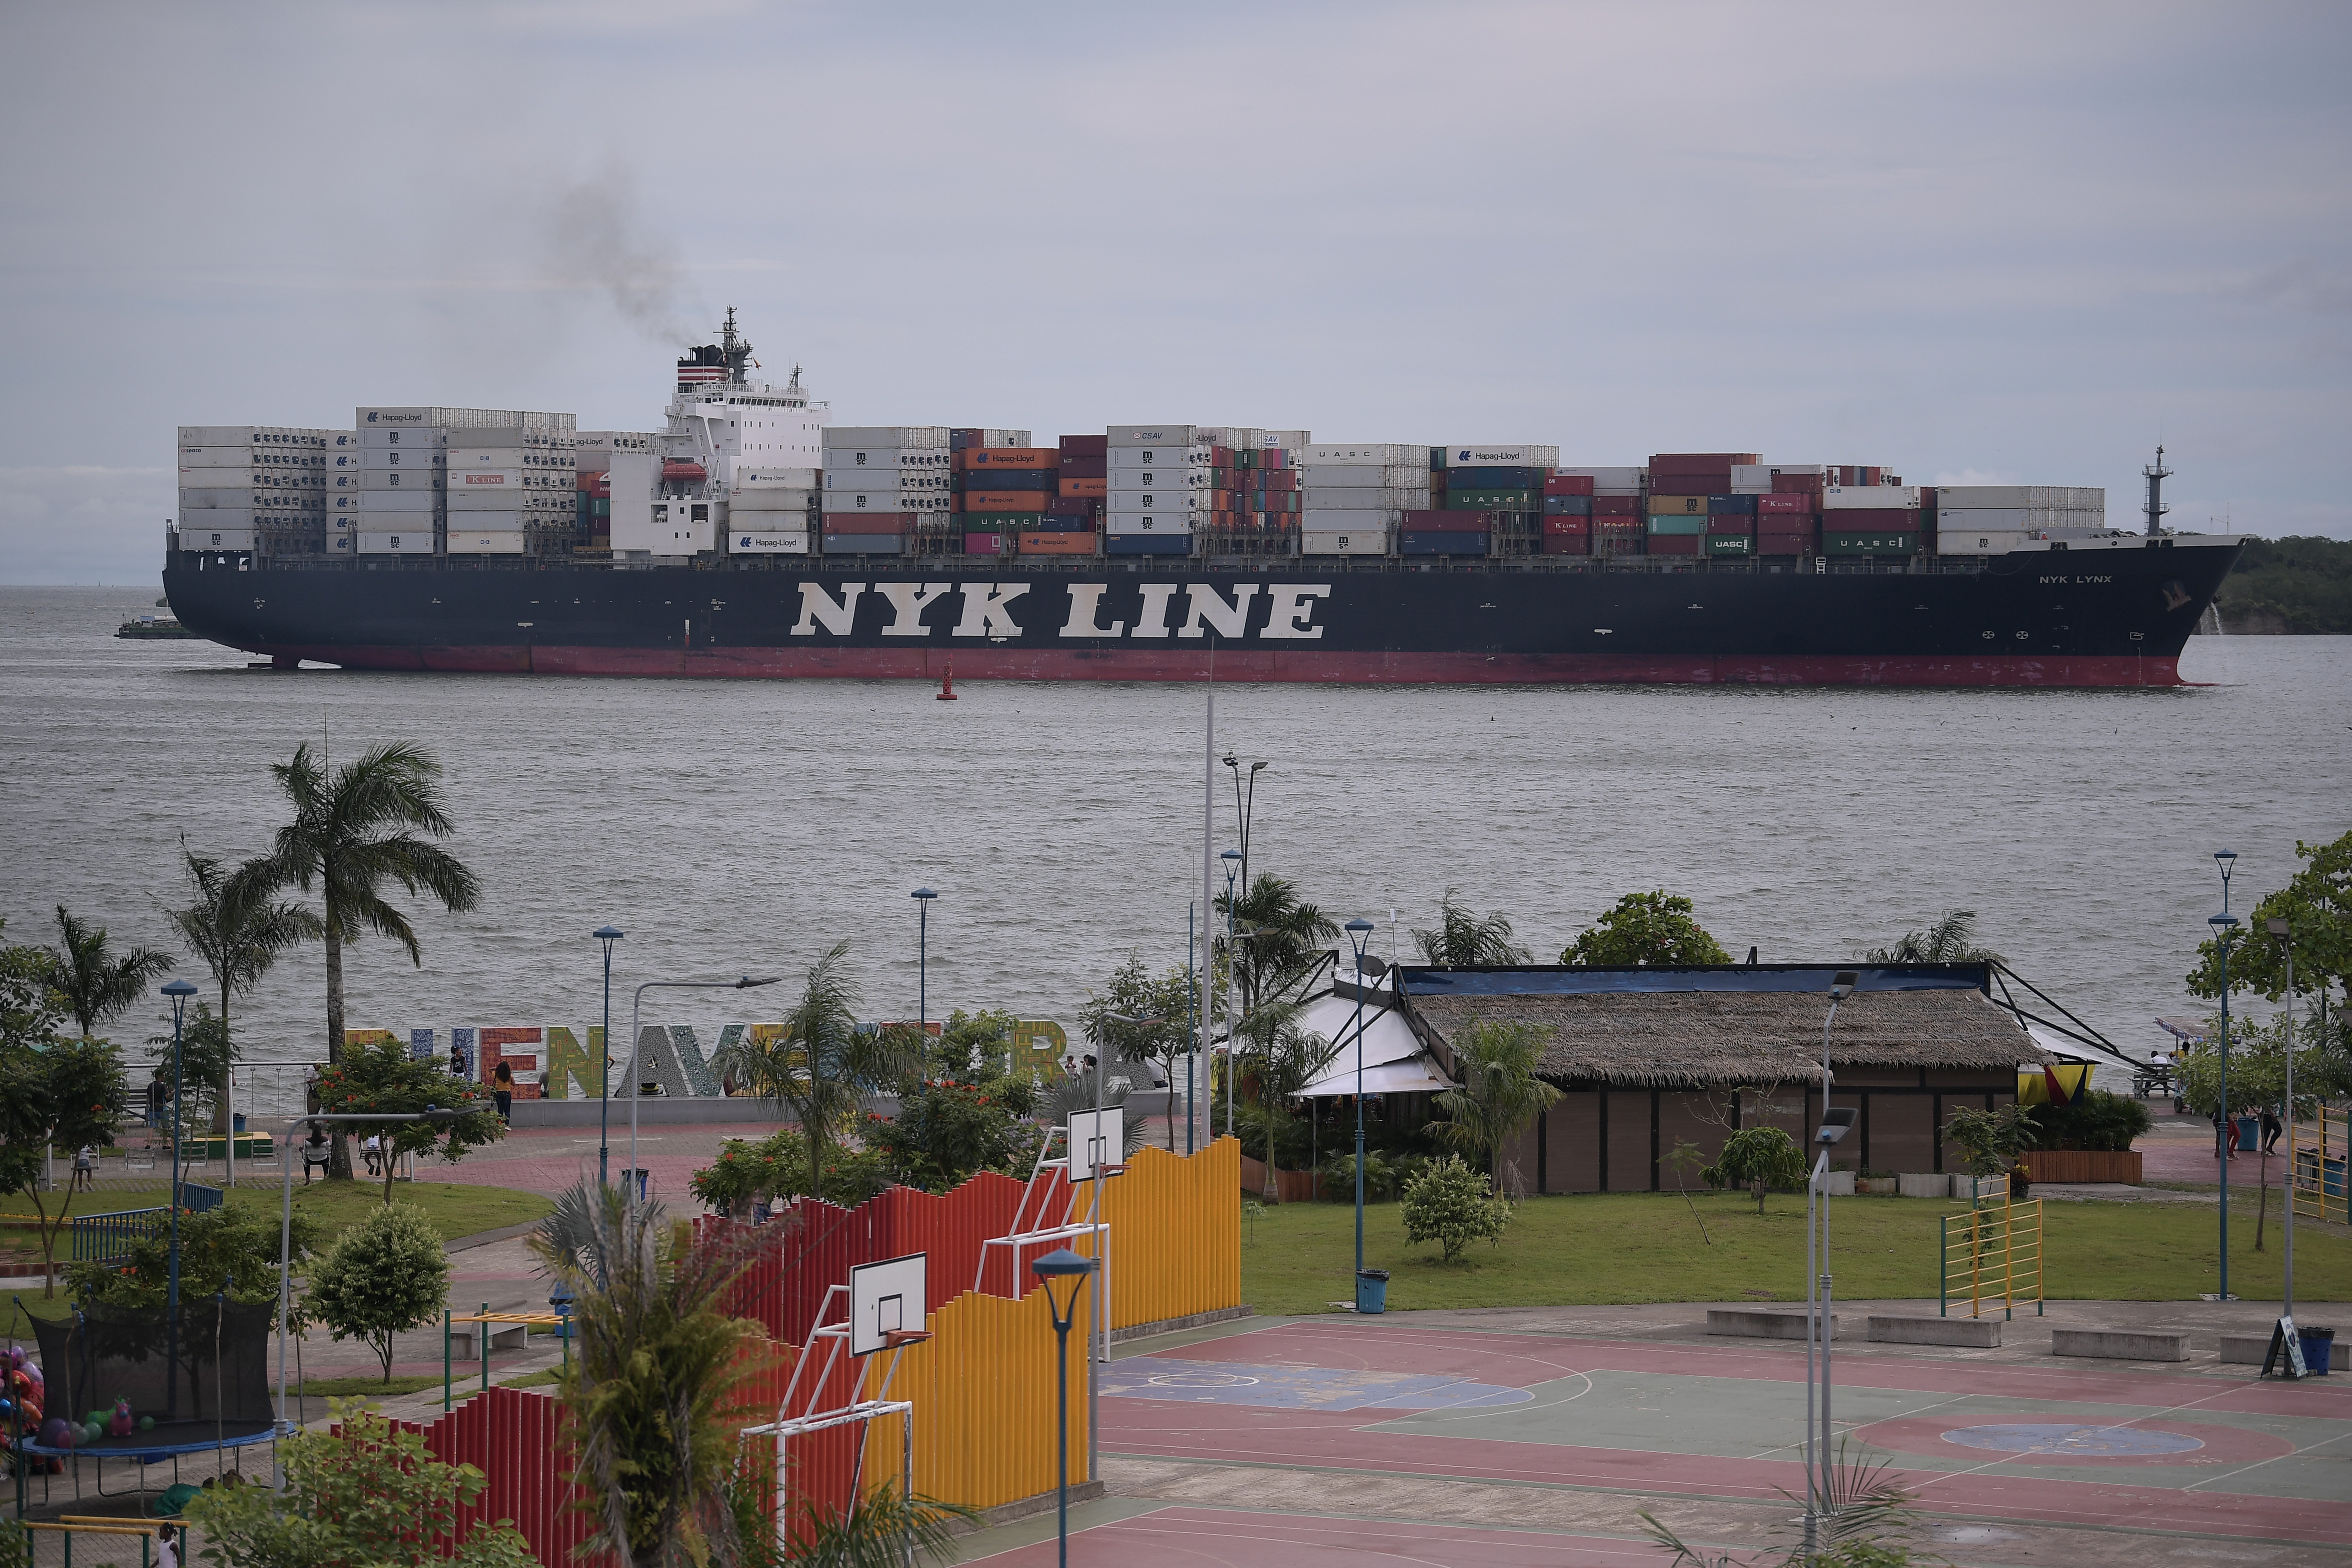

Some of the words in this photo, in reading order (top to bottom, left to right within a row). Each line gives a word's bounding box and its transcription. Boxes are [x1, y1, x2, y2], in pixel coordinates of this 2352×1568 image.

[1196, 434, 1216, 442] -Lloyd
[1475, 452, 1519, 460] Hapag-Lloyd
[789, 582, 1031, 637] NYK
[1059, 583, 1331, 639] LINE
